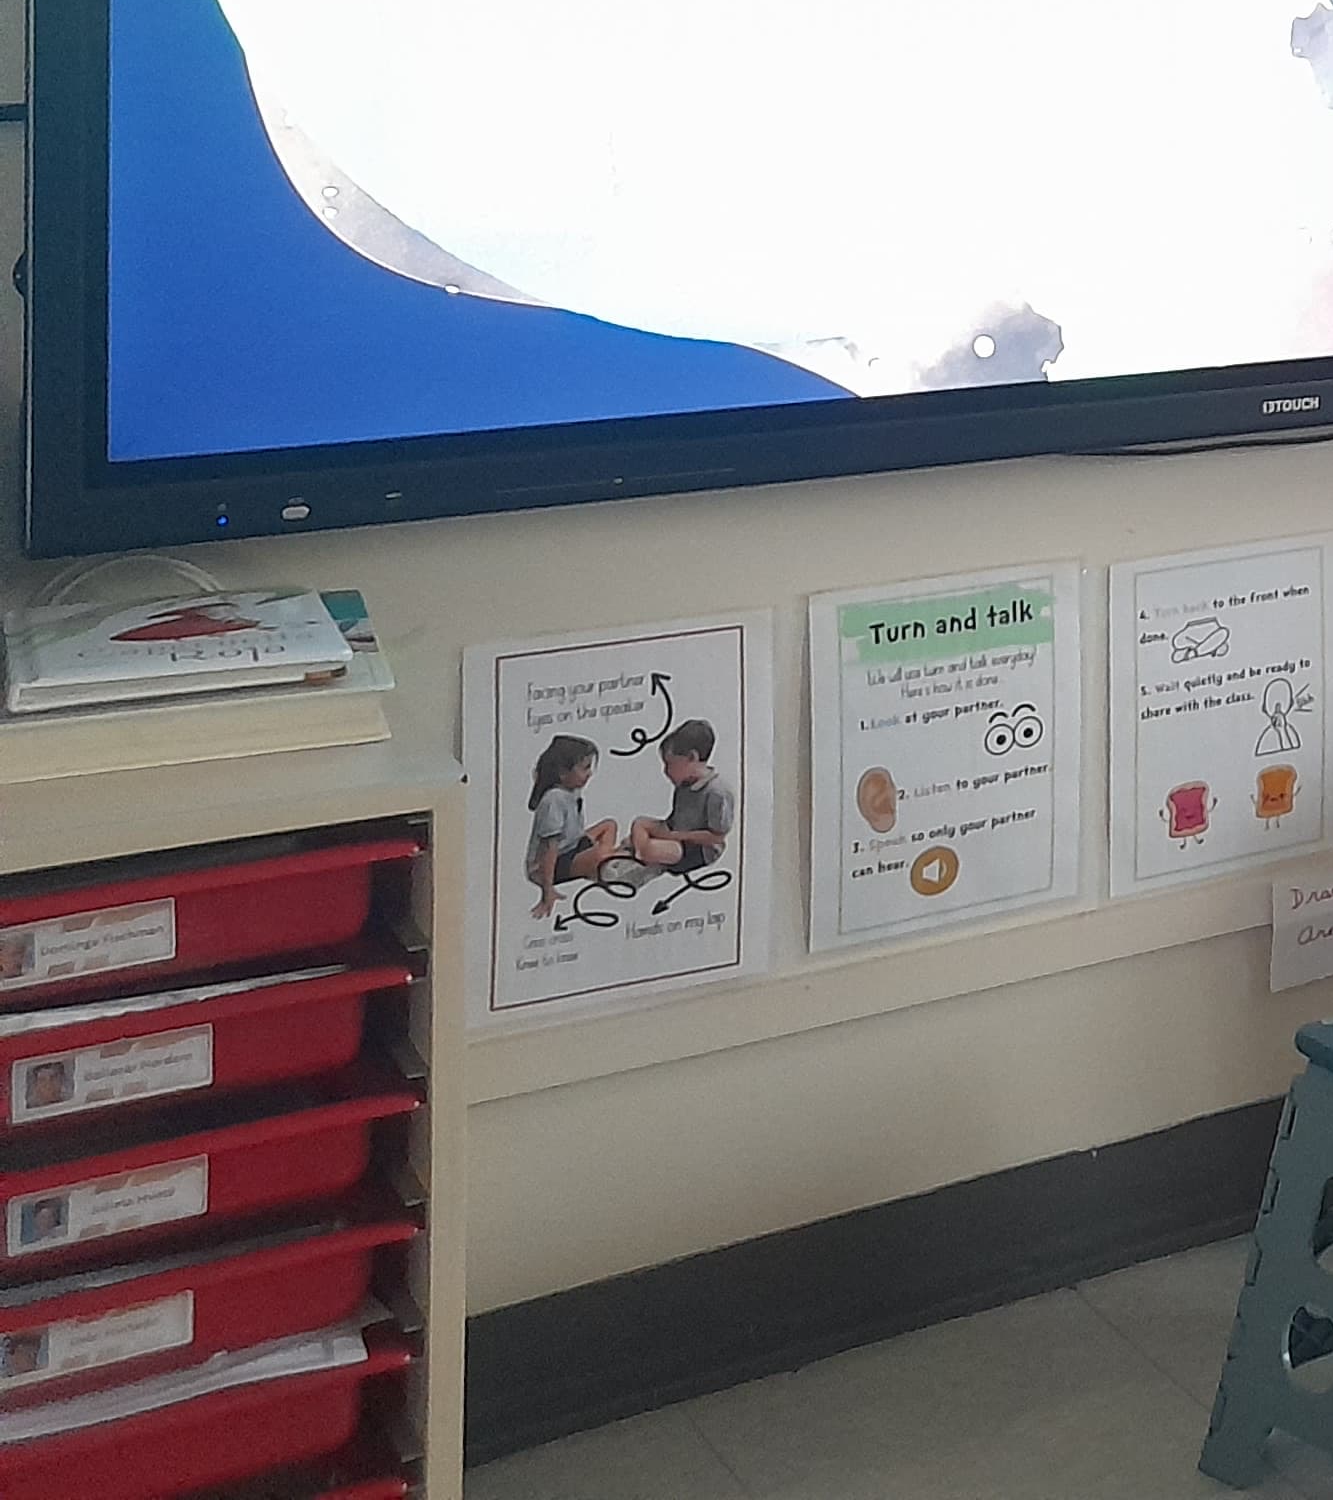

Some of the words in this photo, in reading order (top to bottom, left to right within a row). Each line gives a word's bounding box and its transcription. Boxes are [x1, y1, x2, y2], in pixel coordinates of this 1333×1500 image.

[1213, 599, 1224, 609] to
[1229, 594, 1246, 607] the
[1250, 589, 1278, 604] front
[1283, 585, 1309, 598] when
[869, 622, 925, 644] Turn
[936, 607, 977, 634] and
[987, 599, 1033, 627] talk
[947, 656, 966, 673] and
[1155, 680, 1180, 693] Wait
[1184, 672, 1223, 693] quietly
[1227, 667, 1246, 681] and
[1250, 665, 1262, 677] be
[1265, 659, 1296, 676] ready
[1300, 658, 1311, 668] to
[933, 681, 952, 695] how
[905, 712, 917, 724] at
[922, 707, 950, 724] your
[955, 699, 1004, 718] partner.
[1141, 707, 1171, 721] share
[1175, 700, 1199, 714] with
[1204, 695, 1222, 709] the
[898, 788, 910, 800] 2.
[914, 783, 950, 798] Listen
[957, 778, 968, 791] to
[973, 774, 999, 790] your
[912, 831, 924, 843] so
[929, 824, 955, 841] only
[960, 818, 988, 836] your
[992, 809, 1035, 830] partner
[852, 866, 873, 879] can
[878, 860, 909, 874] hear.
[667, 920, 681, 932] on
[685, 917, 704, 934] my
